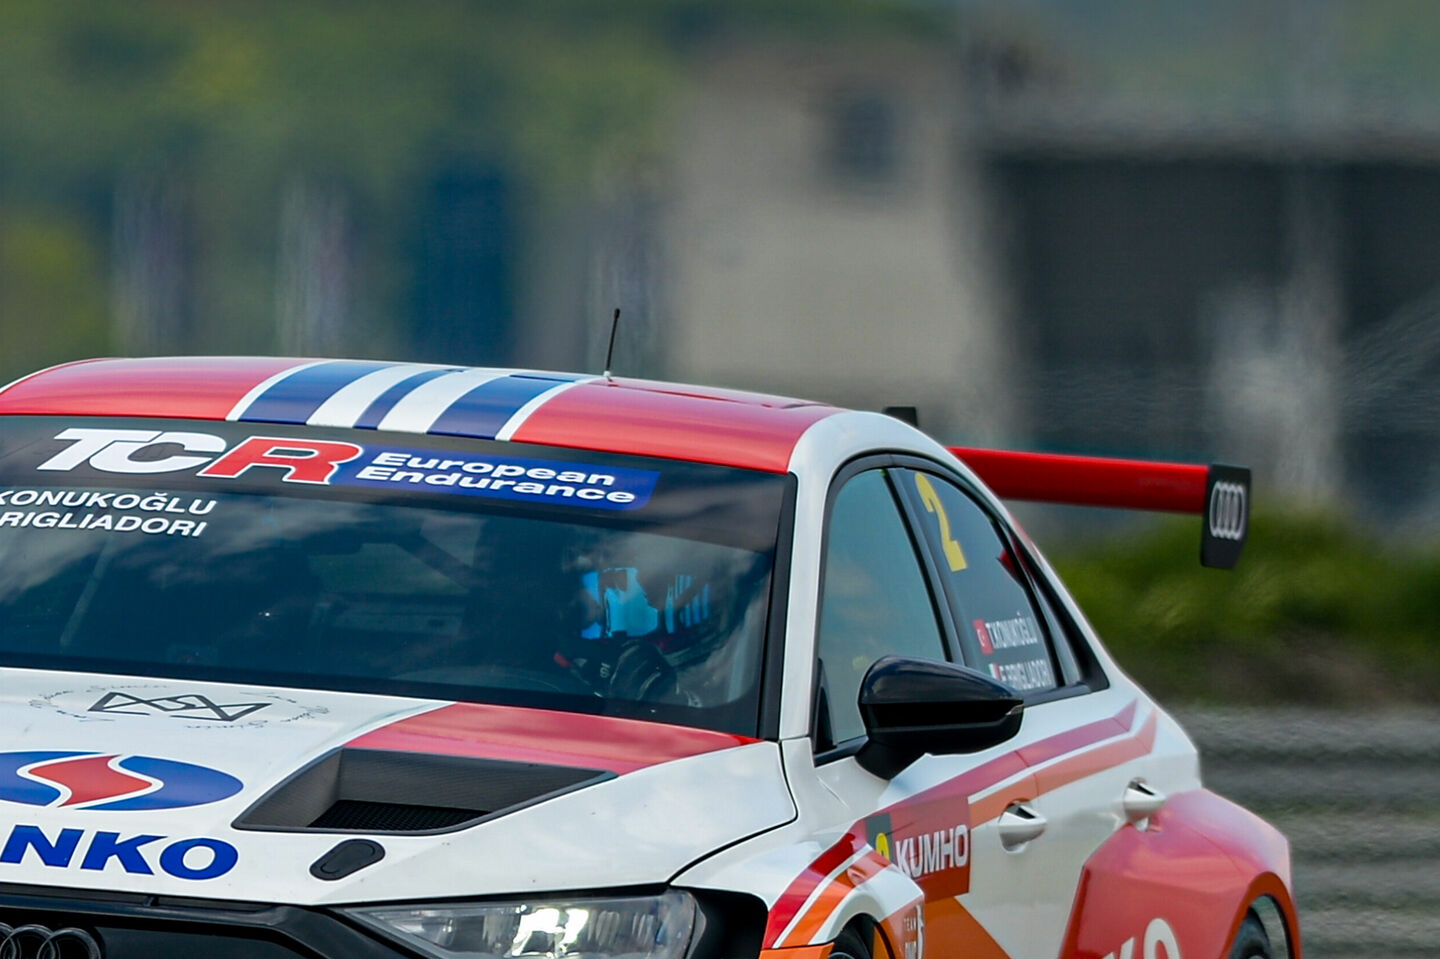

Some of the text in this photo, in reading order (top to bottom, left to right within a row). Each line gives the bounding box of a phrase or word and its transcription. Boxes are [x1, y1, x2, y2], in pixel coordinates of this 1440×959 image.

[37, 428, 363, 486] TCR
[371, 452, 617, 487] European
[355, 465, 636, 504] Endurance
[914, 472, 968, 572] 2
[895, 824, 969, 878] KUMHO
